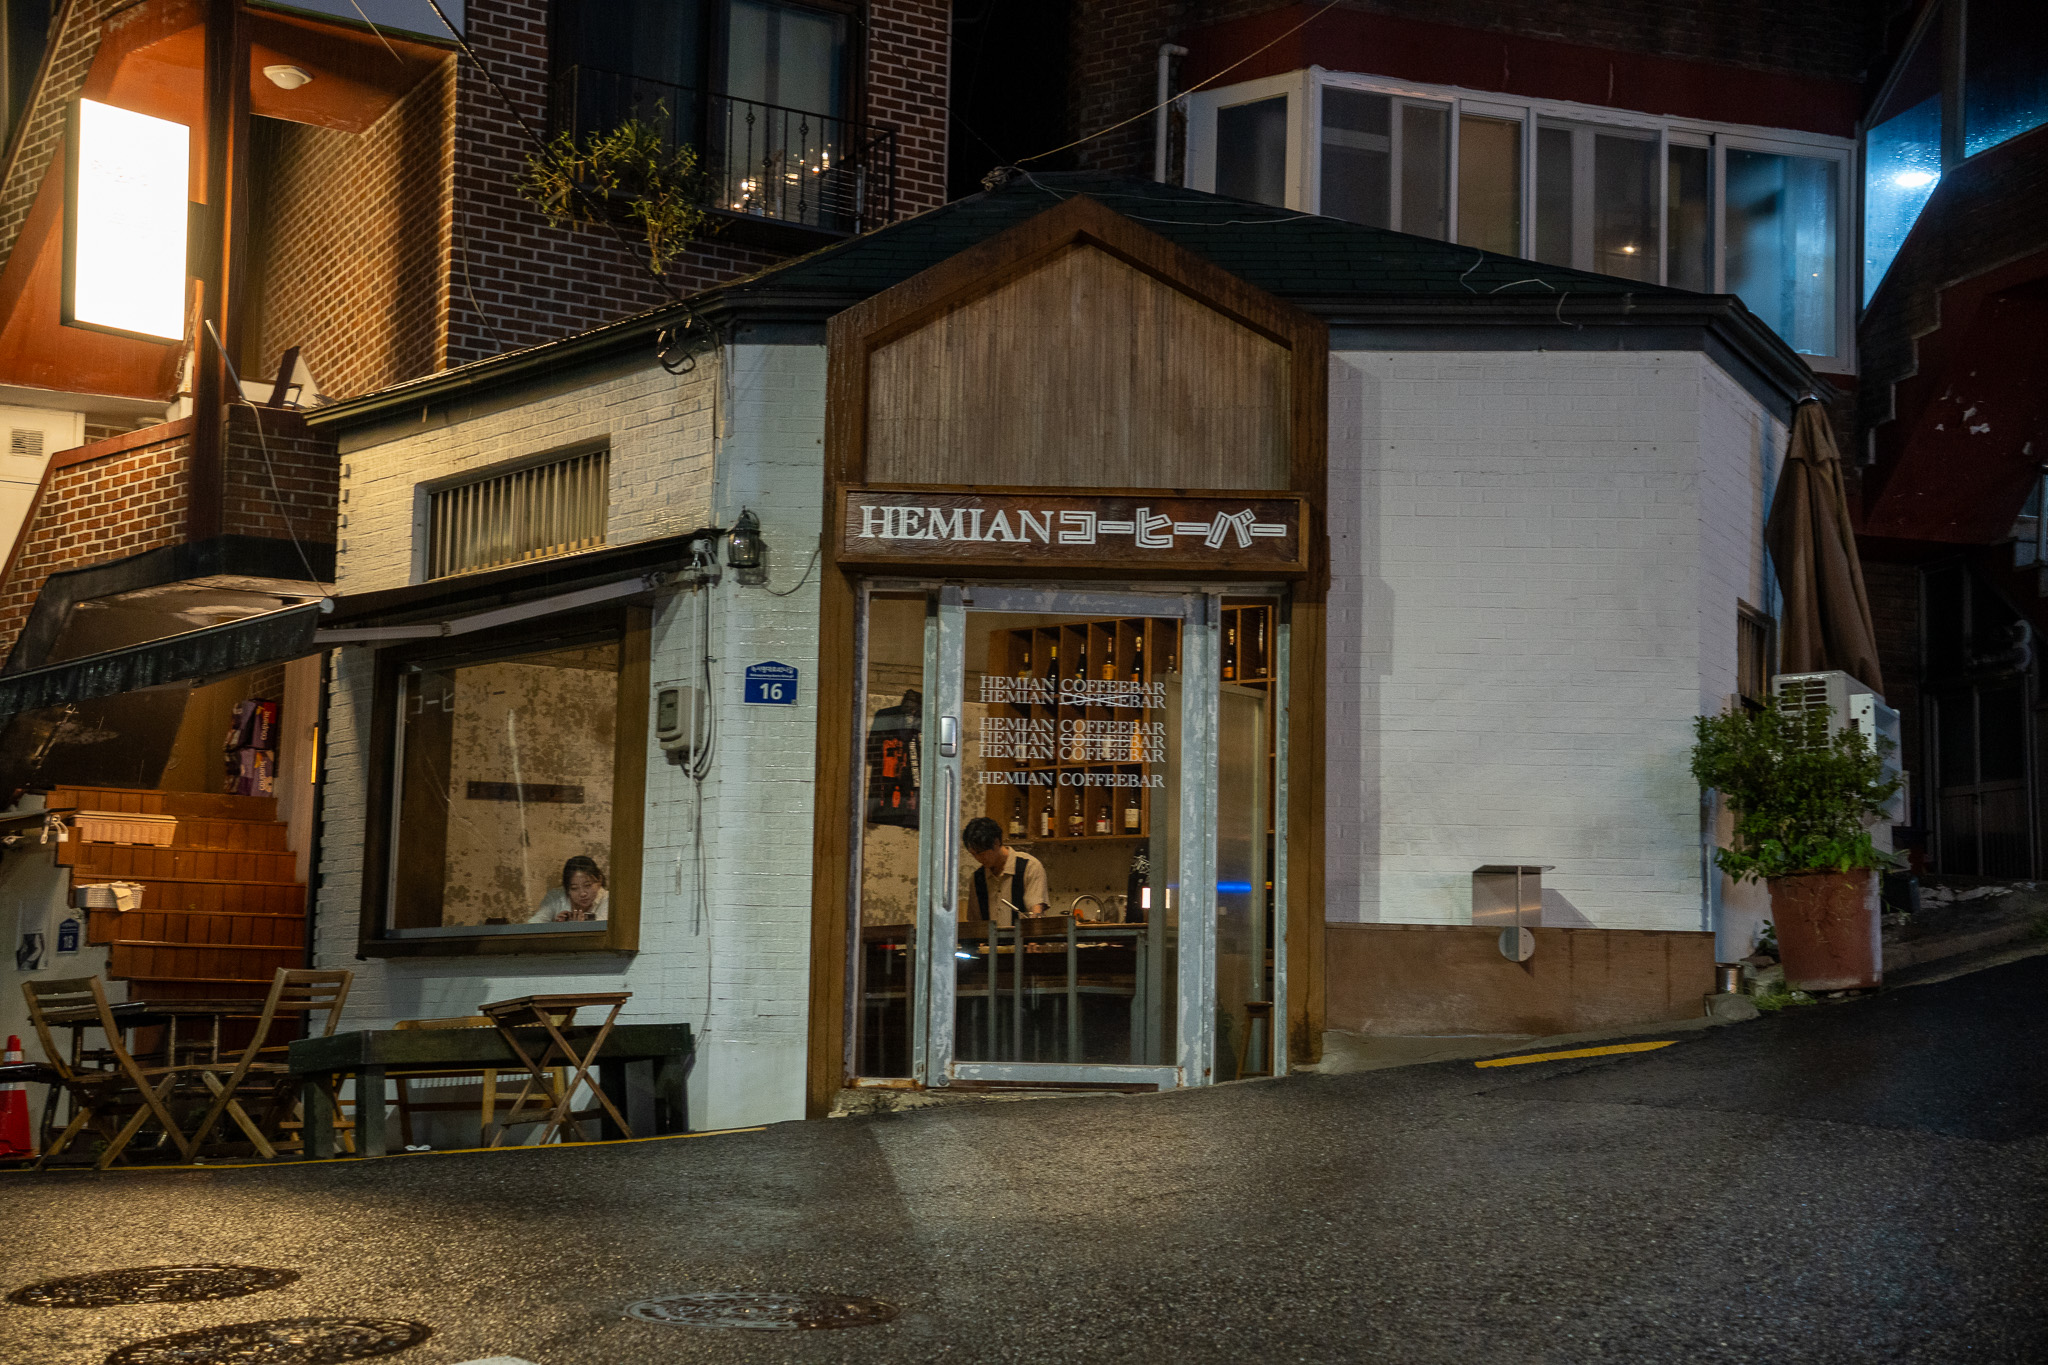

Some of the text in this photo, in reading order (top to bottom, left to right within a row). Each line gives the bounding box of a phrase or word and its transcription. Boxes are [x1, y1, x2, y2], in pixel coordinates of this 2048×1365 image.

[859, 505, 1287, 549] HEMIAN コーヒーバー
[760, 683, 783, 700] 16
[980, 675, 1167, 696] HEMIAN COFFEEBAR
[980, 690, 1055, 705] HEMIAN
[979, 717, 1167, 736] HEMIAN COFFEEBAR
[979, 731, 1167, 750] HEMIAN COFFEEBAR
[978, 744, 1166, 763] HEMIAN COFFEEBAR
[978, 771, 1165, 788] HEMIAN COFFEEBAR
